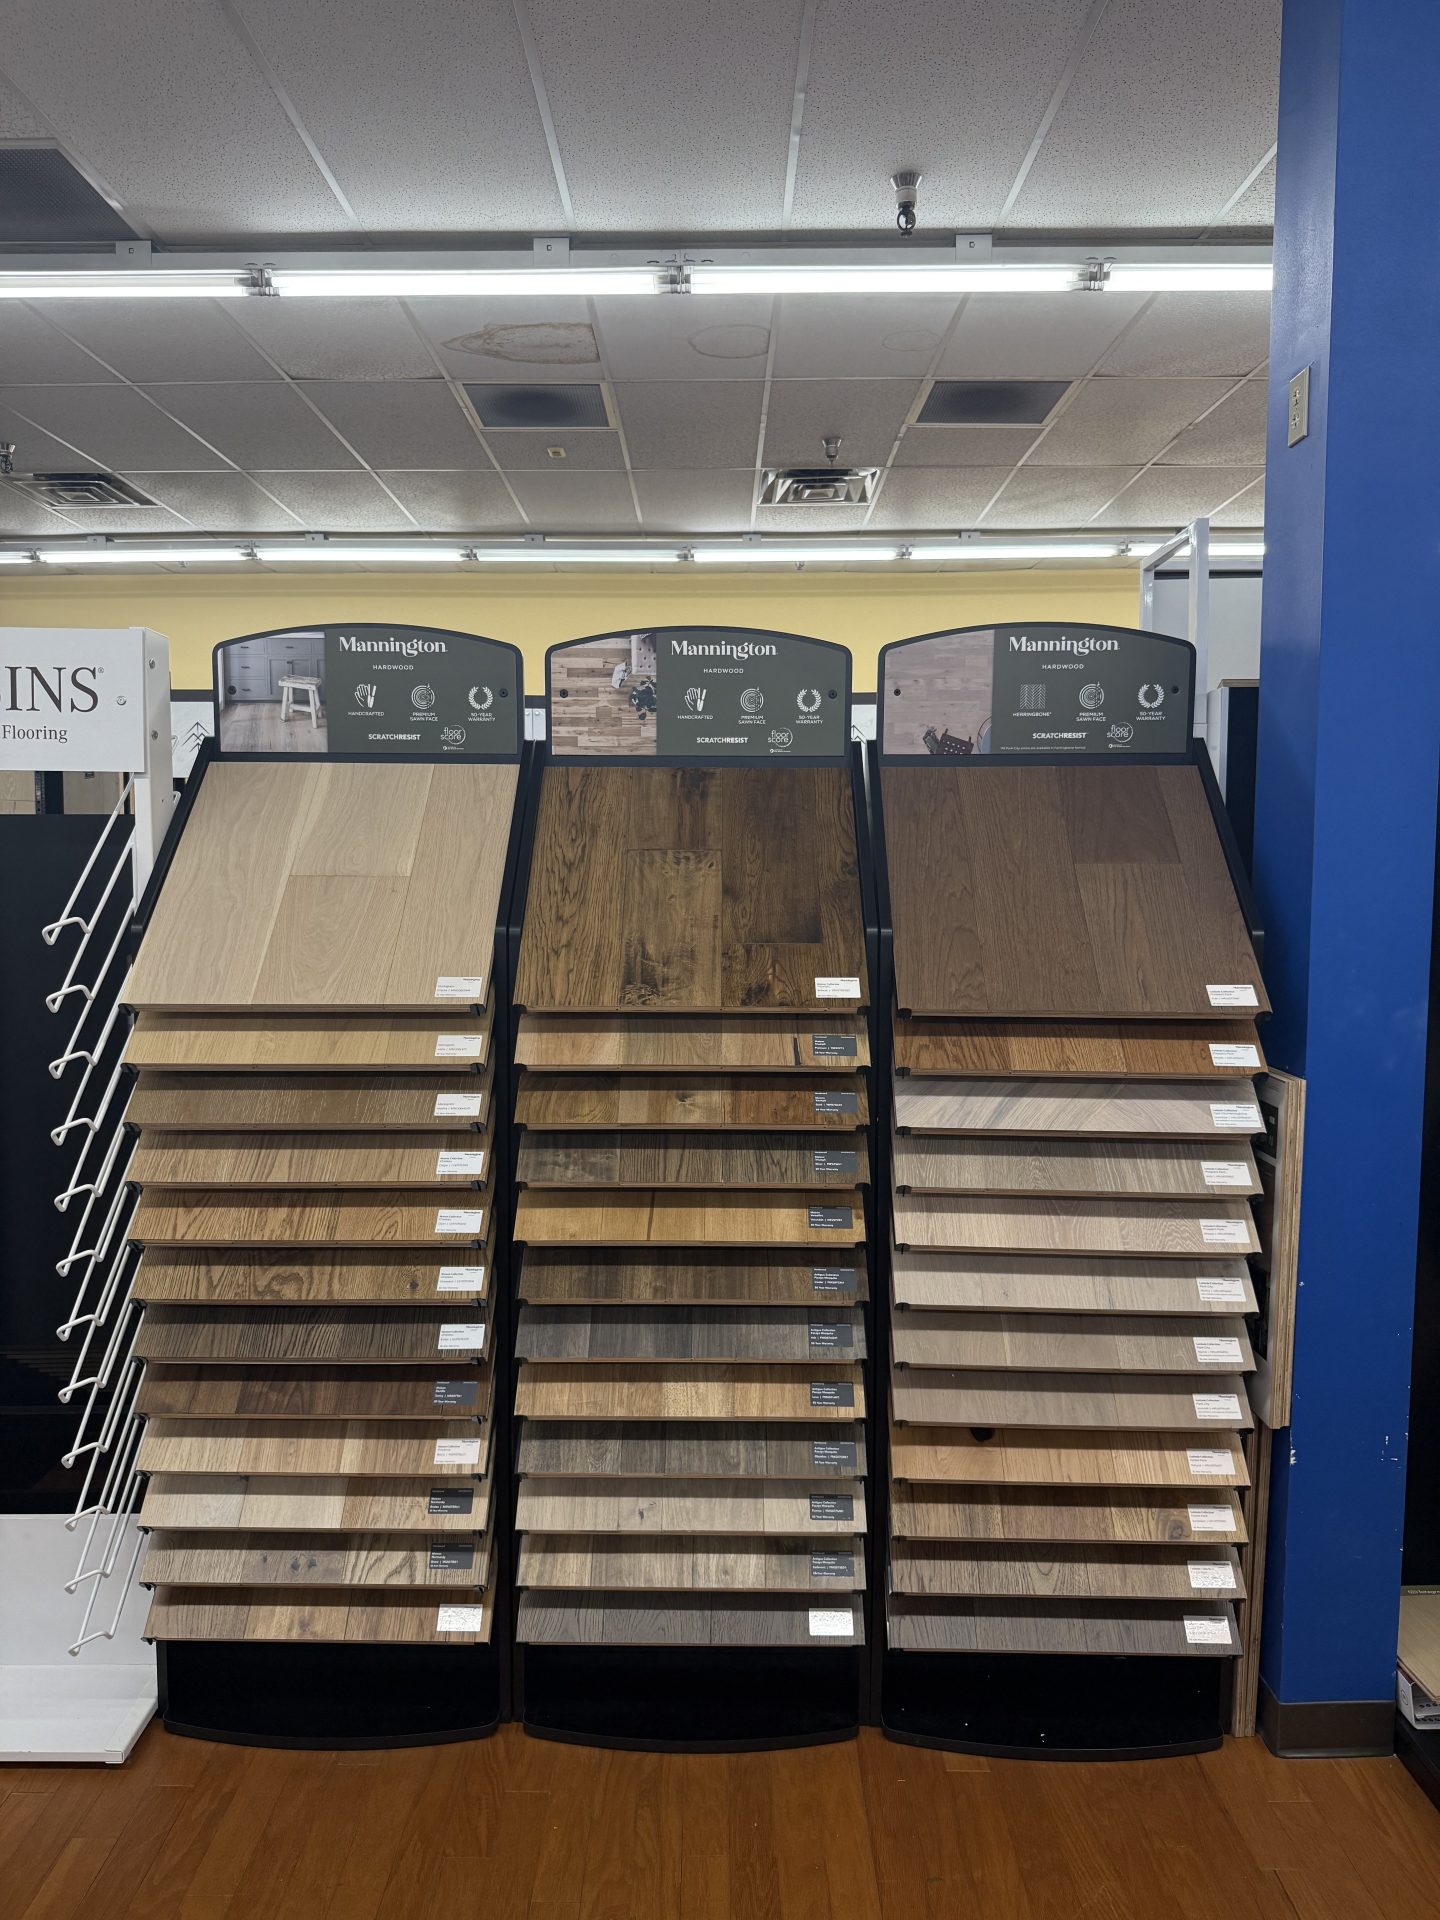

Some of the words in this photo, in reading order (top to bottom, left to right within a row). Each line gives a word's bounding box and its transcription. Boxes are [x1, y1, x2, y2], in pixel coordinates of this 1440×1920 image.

[339, 636, 447, 658] Mannington
[671, 640, 777, 661] Mannington
[1009, 636, 1119, 657] Mannington
[0, 665, 98, 713] INS
[2, 725, 68, 743] Flooring
[368, 733, 421, 741] SCRATCHRESIST
